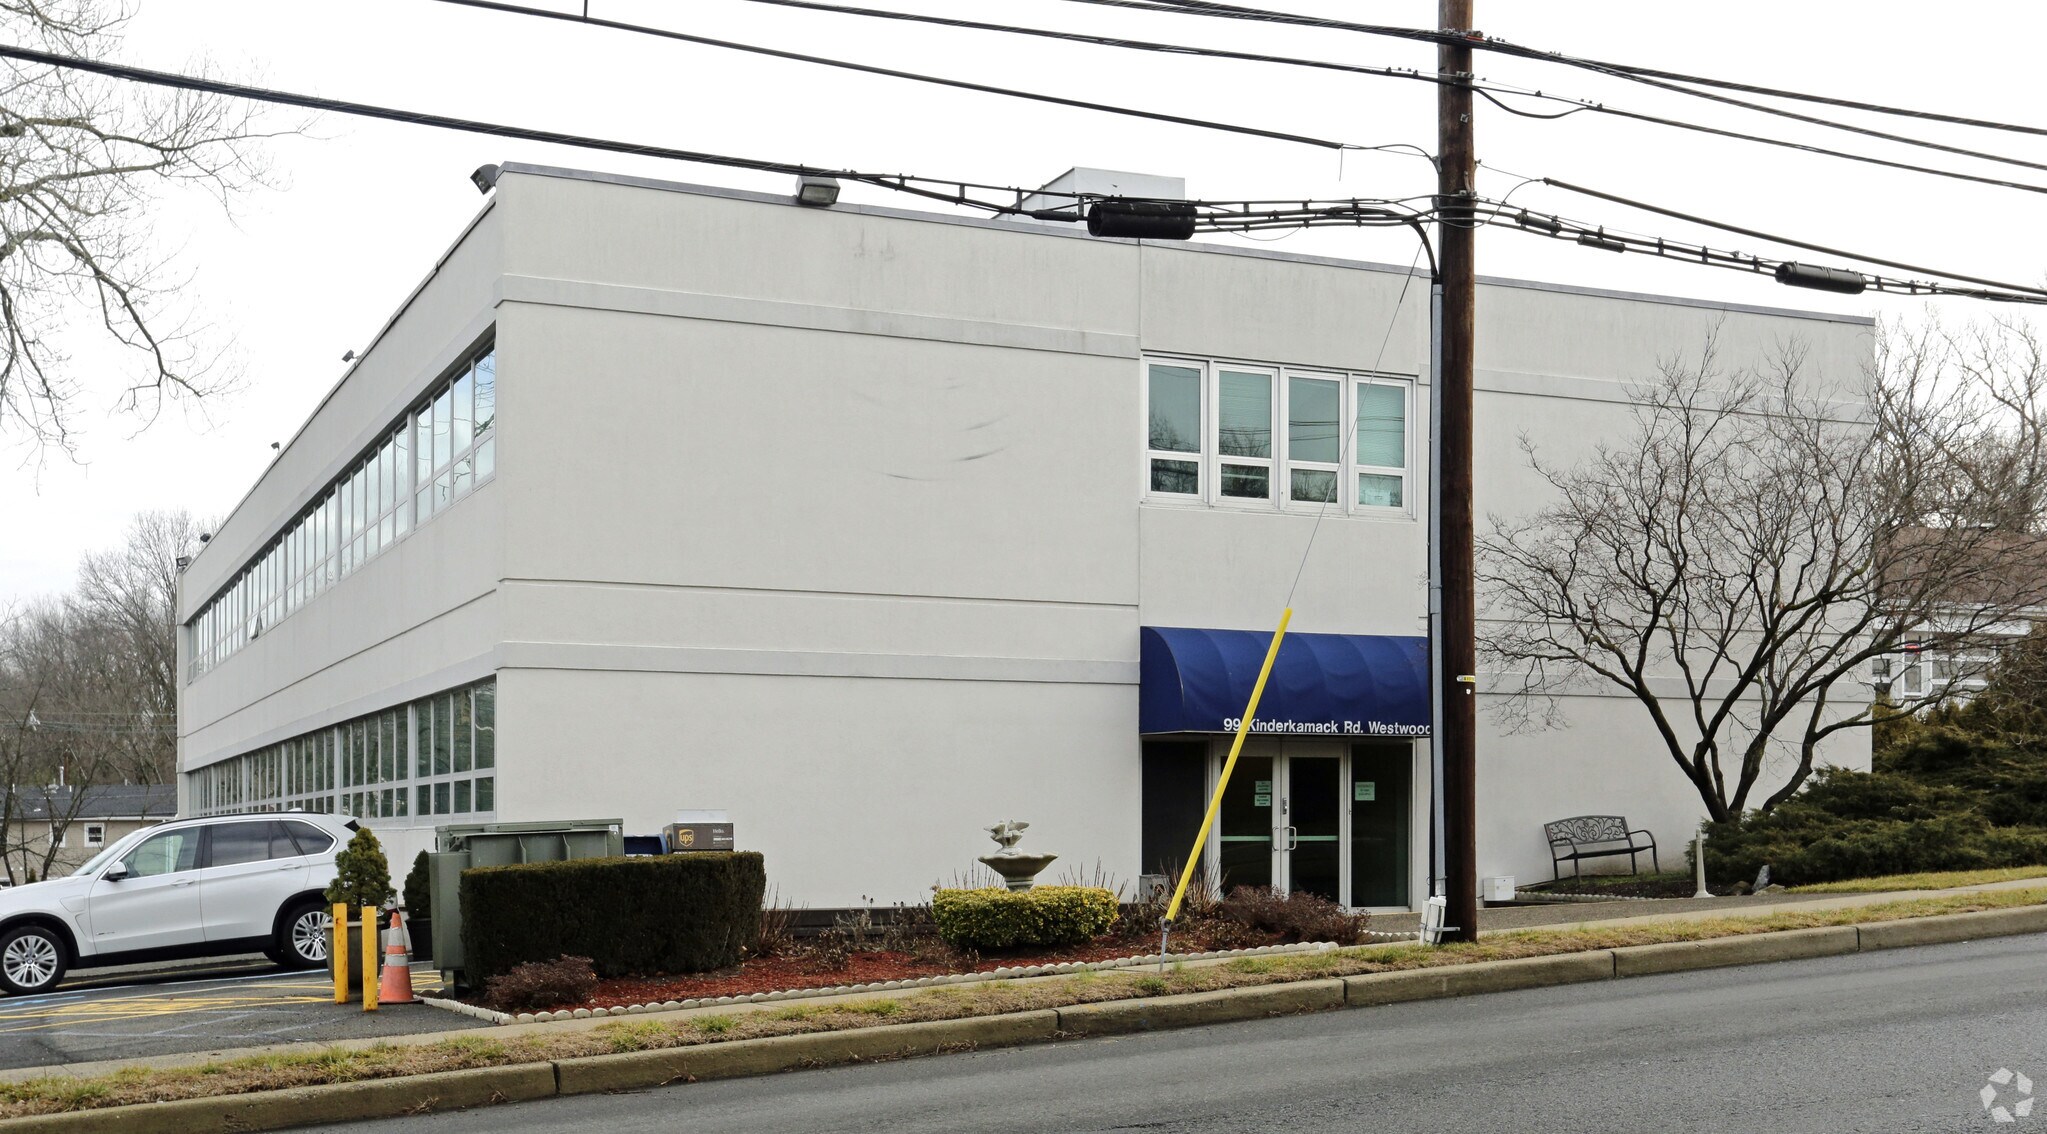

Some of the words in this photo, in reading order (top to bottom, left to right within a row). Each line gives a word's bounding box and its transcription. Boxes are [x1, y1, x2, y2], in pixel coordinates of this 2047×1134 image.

[1223, 718, 1242, 732] 99
[1248, 718, 1339, 733] Kinderkamack
[1344, 720, 1364, 734] Rd.
